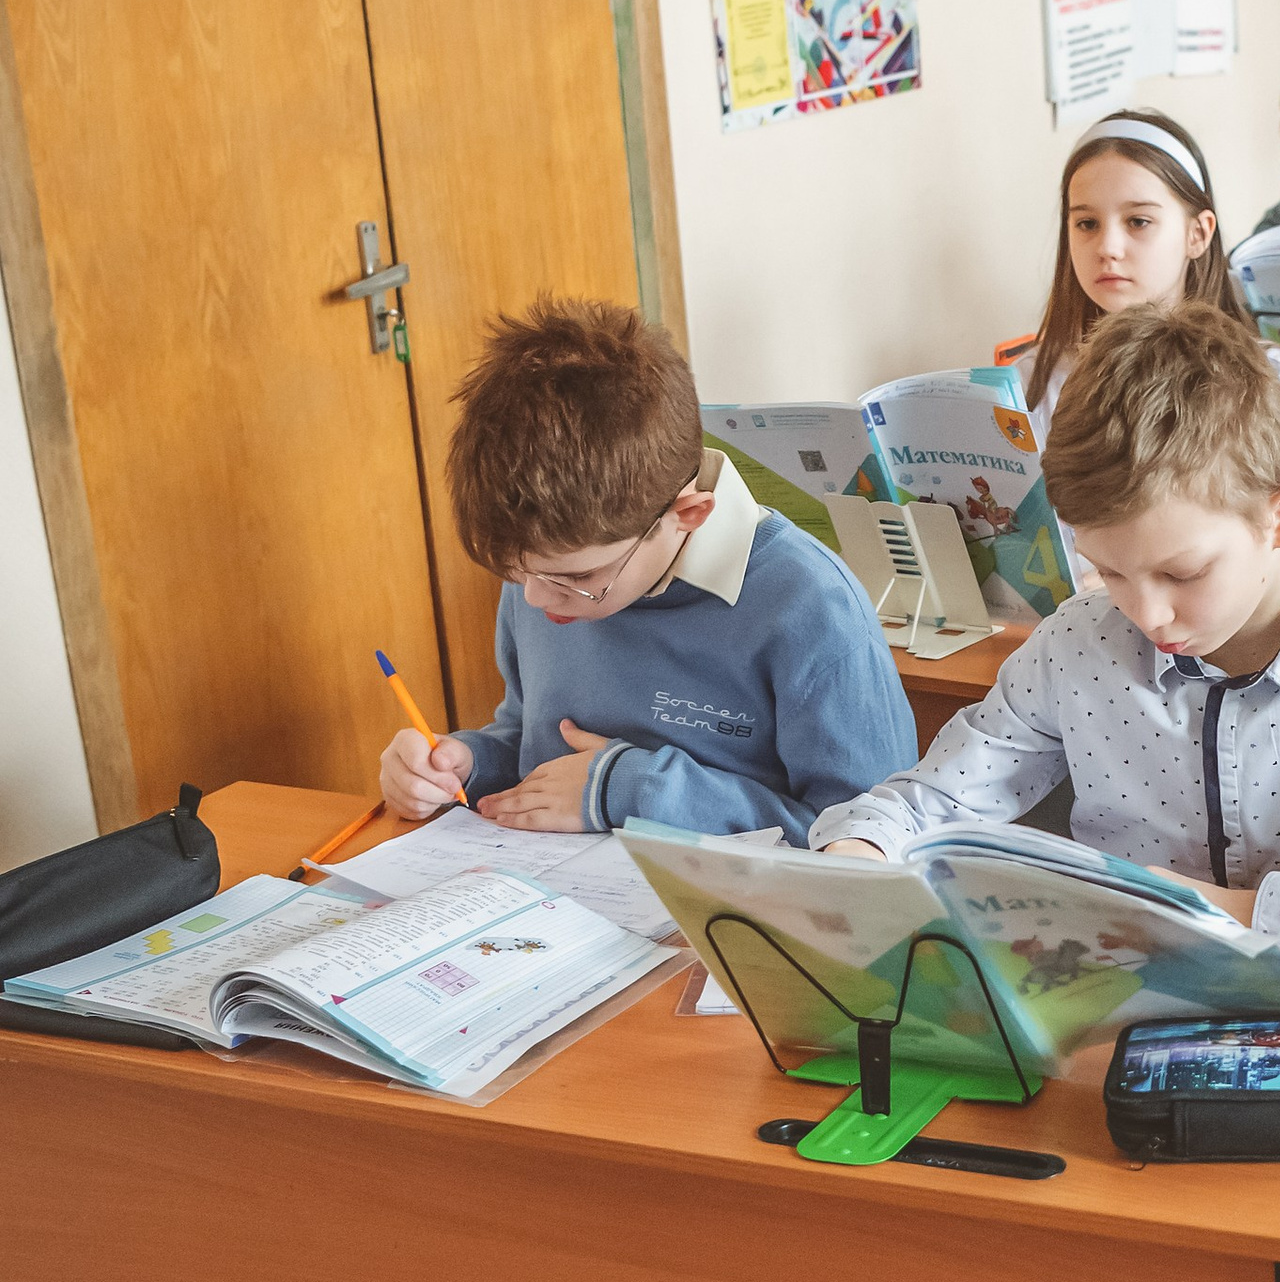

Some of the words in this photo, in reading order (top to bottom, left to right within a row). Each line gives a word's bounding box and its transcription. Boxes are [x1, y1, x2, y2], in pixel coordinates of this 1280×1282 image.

[889, 446, 1027, 476] Математика
[1022, 525, 1071, 607] 4
[654, 691, 755, 722] Soccer
